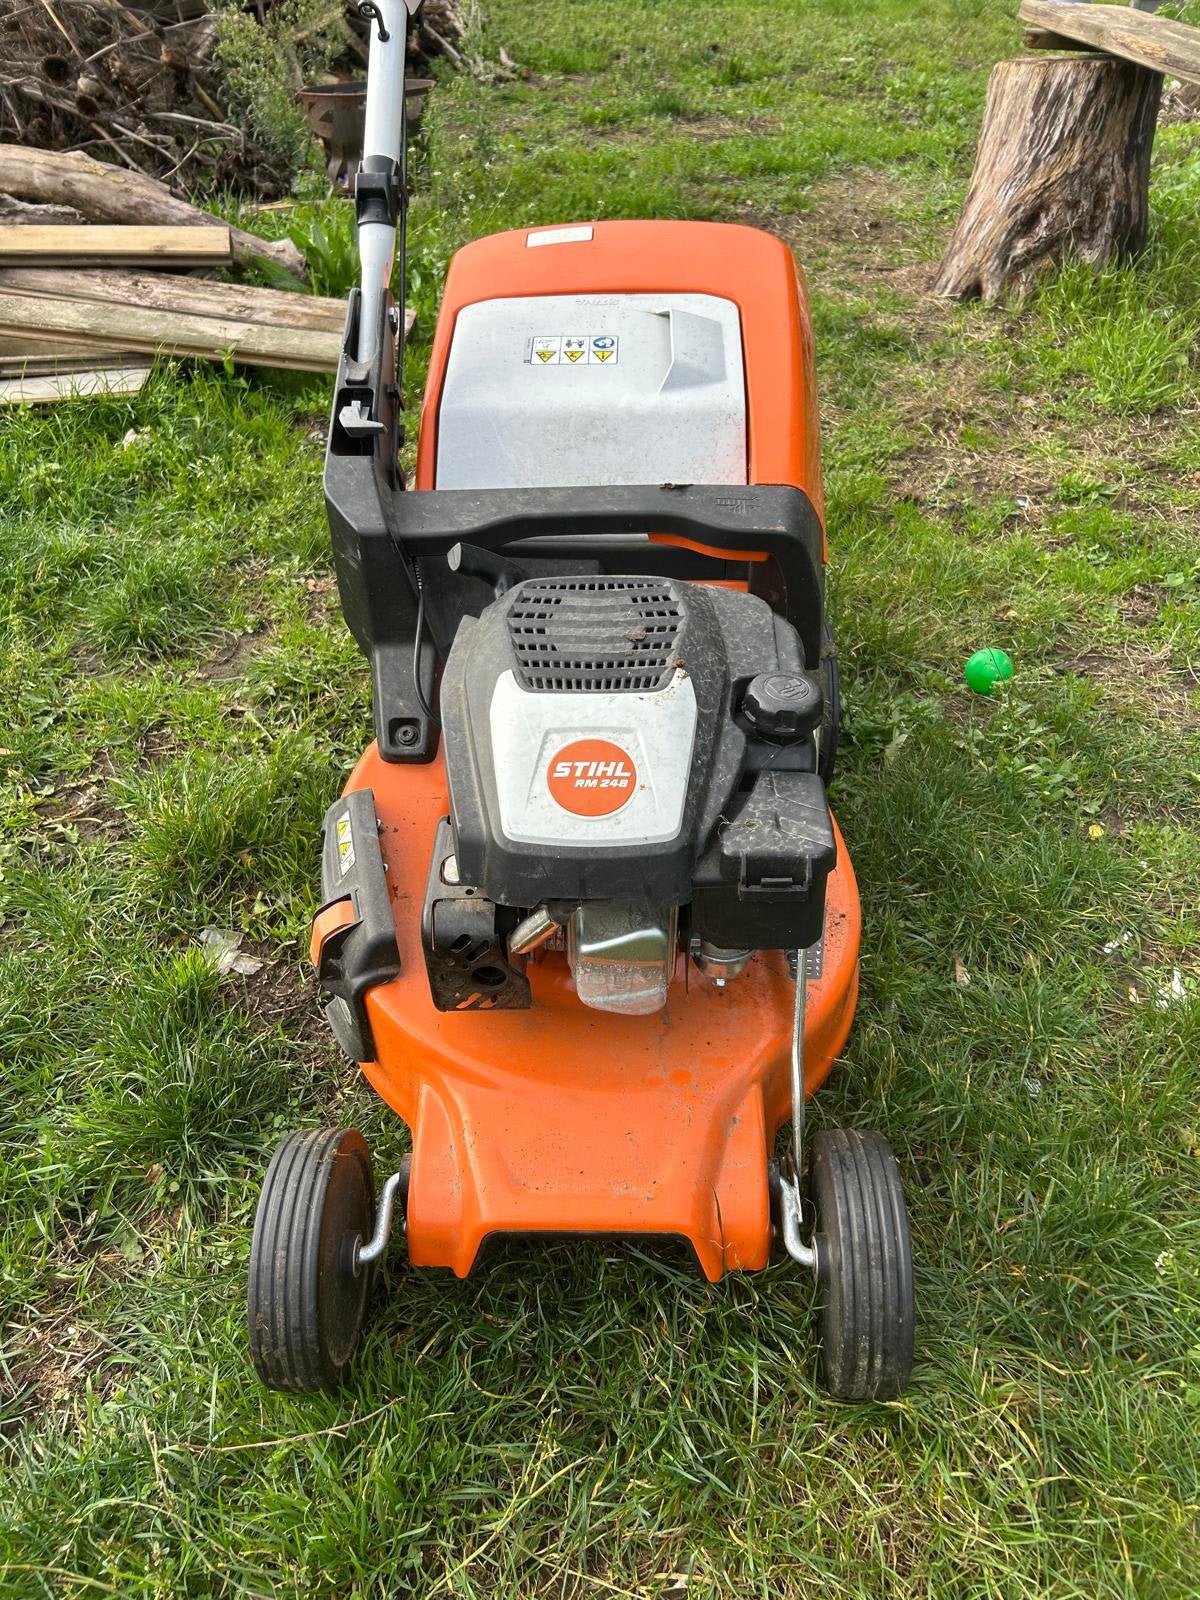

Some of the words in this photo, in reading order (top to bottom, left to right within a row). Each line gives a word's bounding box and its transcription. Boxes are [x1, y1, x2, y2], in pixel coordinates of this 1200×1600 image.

[552, 761, 632, 778] STIHL
[574, 779, 598, 788] RM
[600, 779, 629, 788] 248
